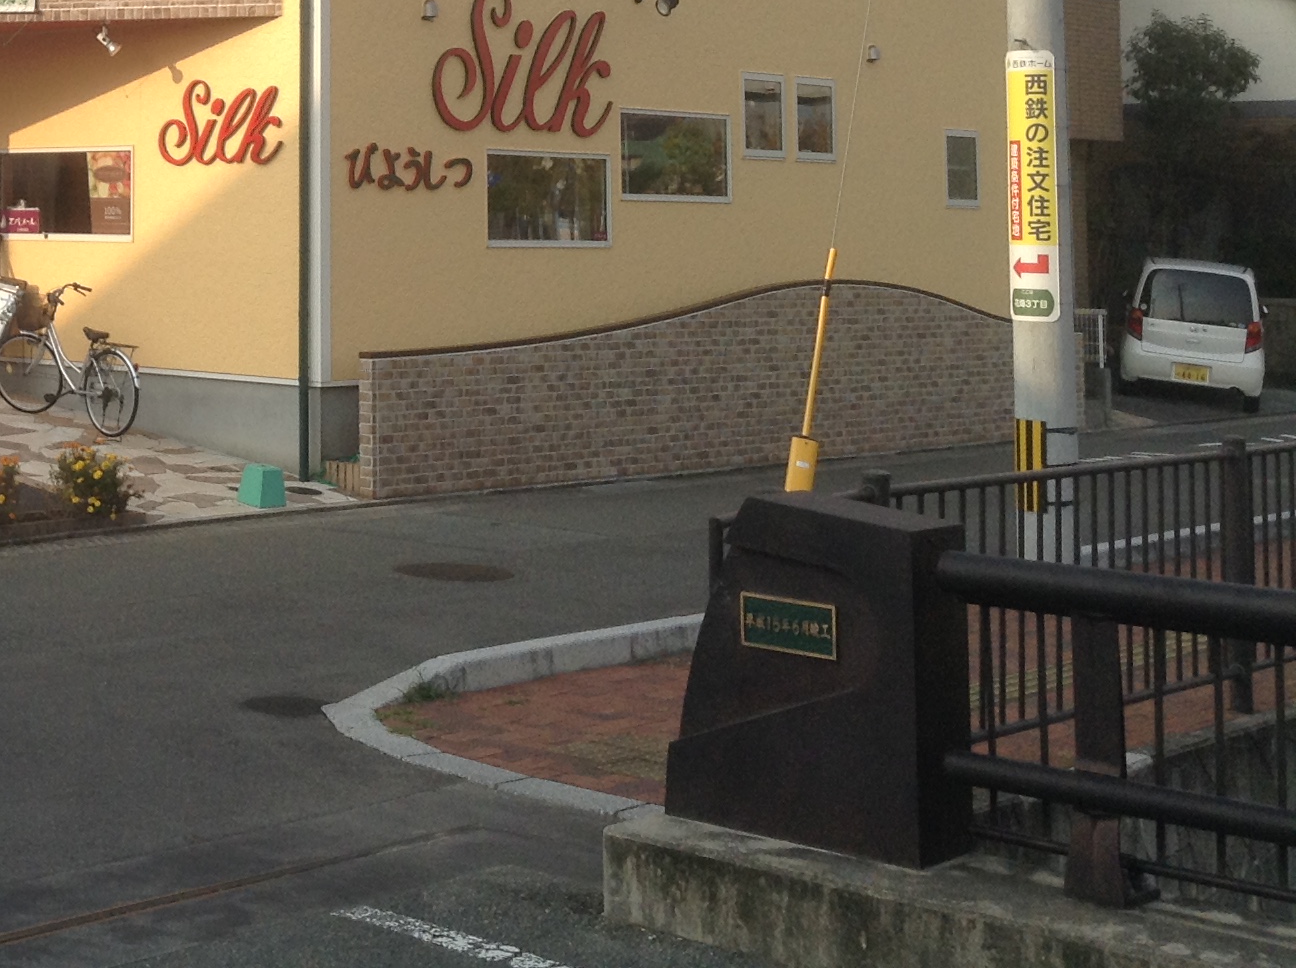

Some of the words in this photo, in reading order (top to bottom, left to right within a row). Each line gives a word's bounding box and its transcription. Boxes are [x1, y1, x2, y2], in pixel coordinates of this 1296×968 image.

[158, 79, 284, 167] Silk
[1024, 73, 1051, 242] 西鉄の注文住宅
